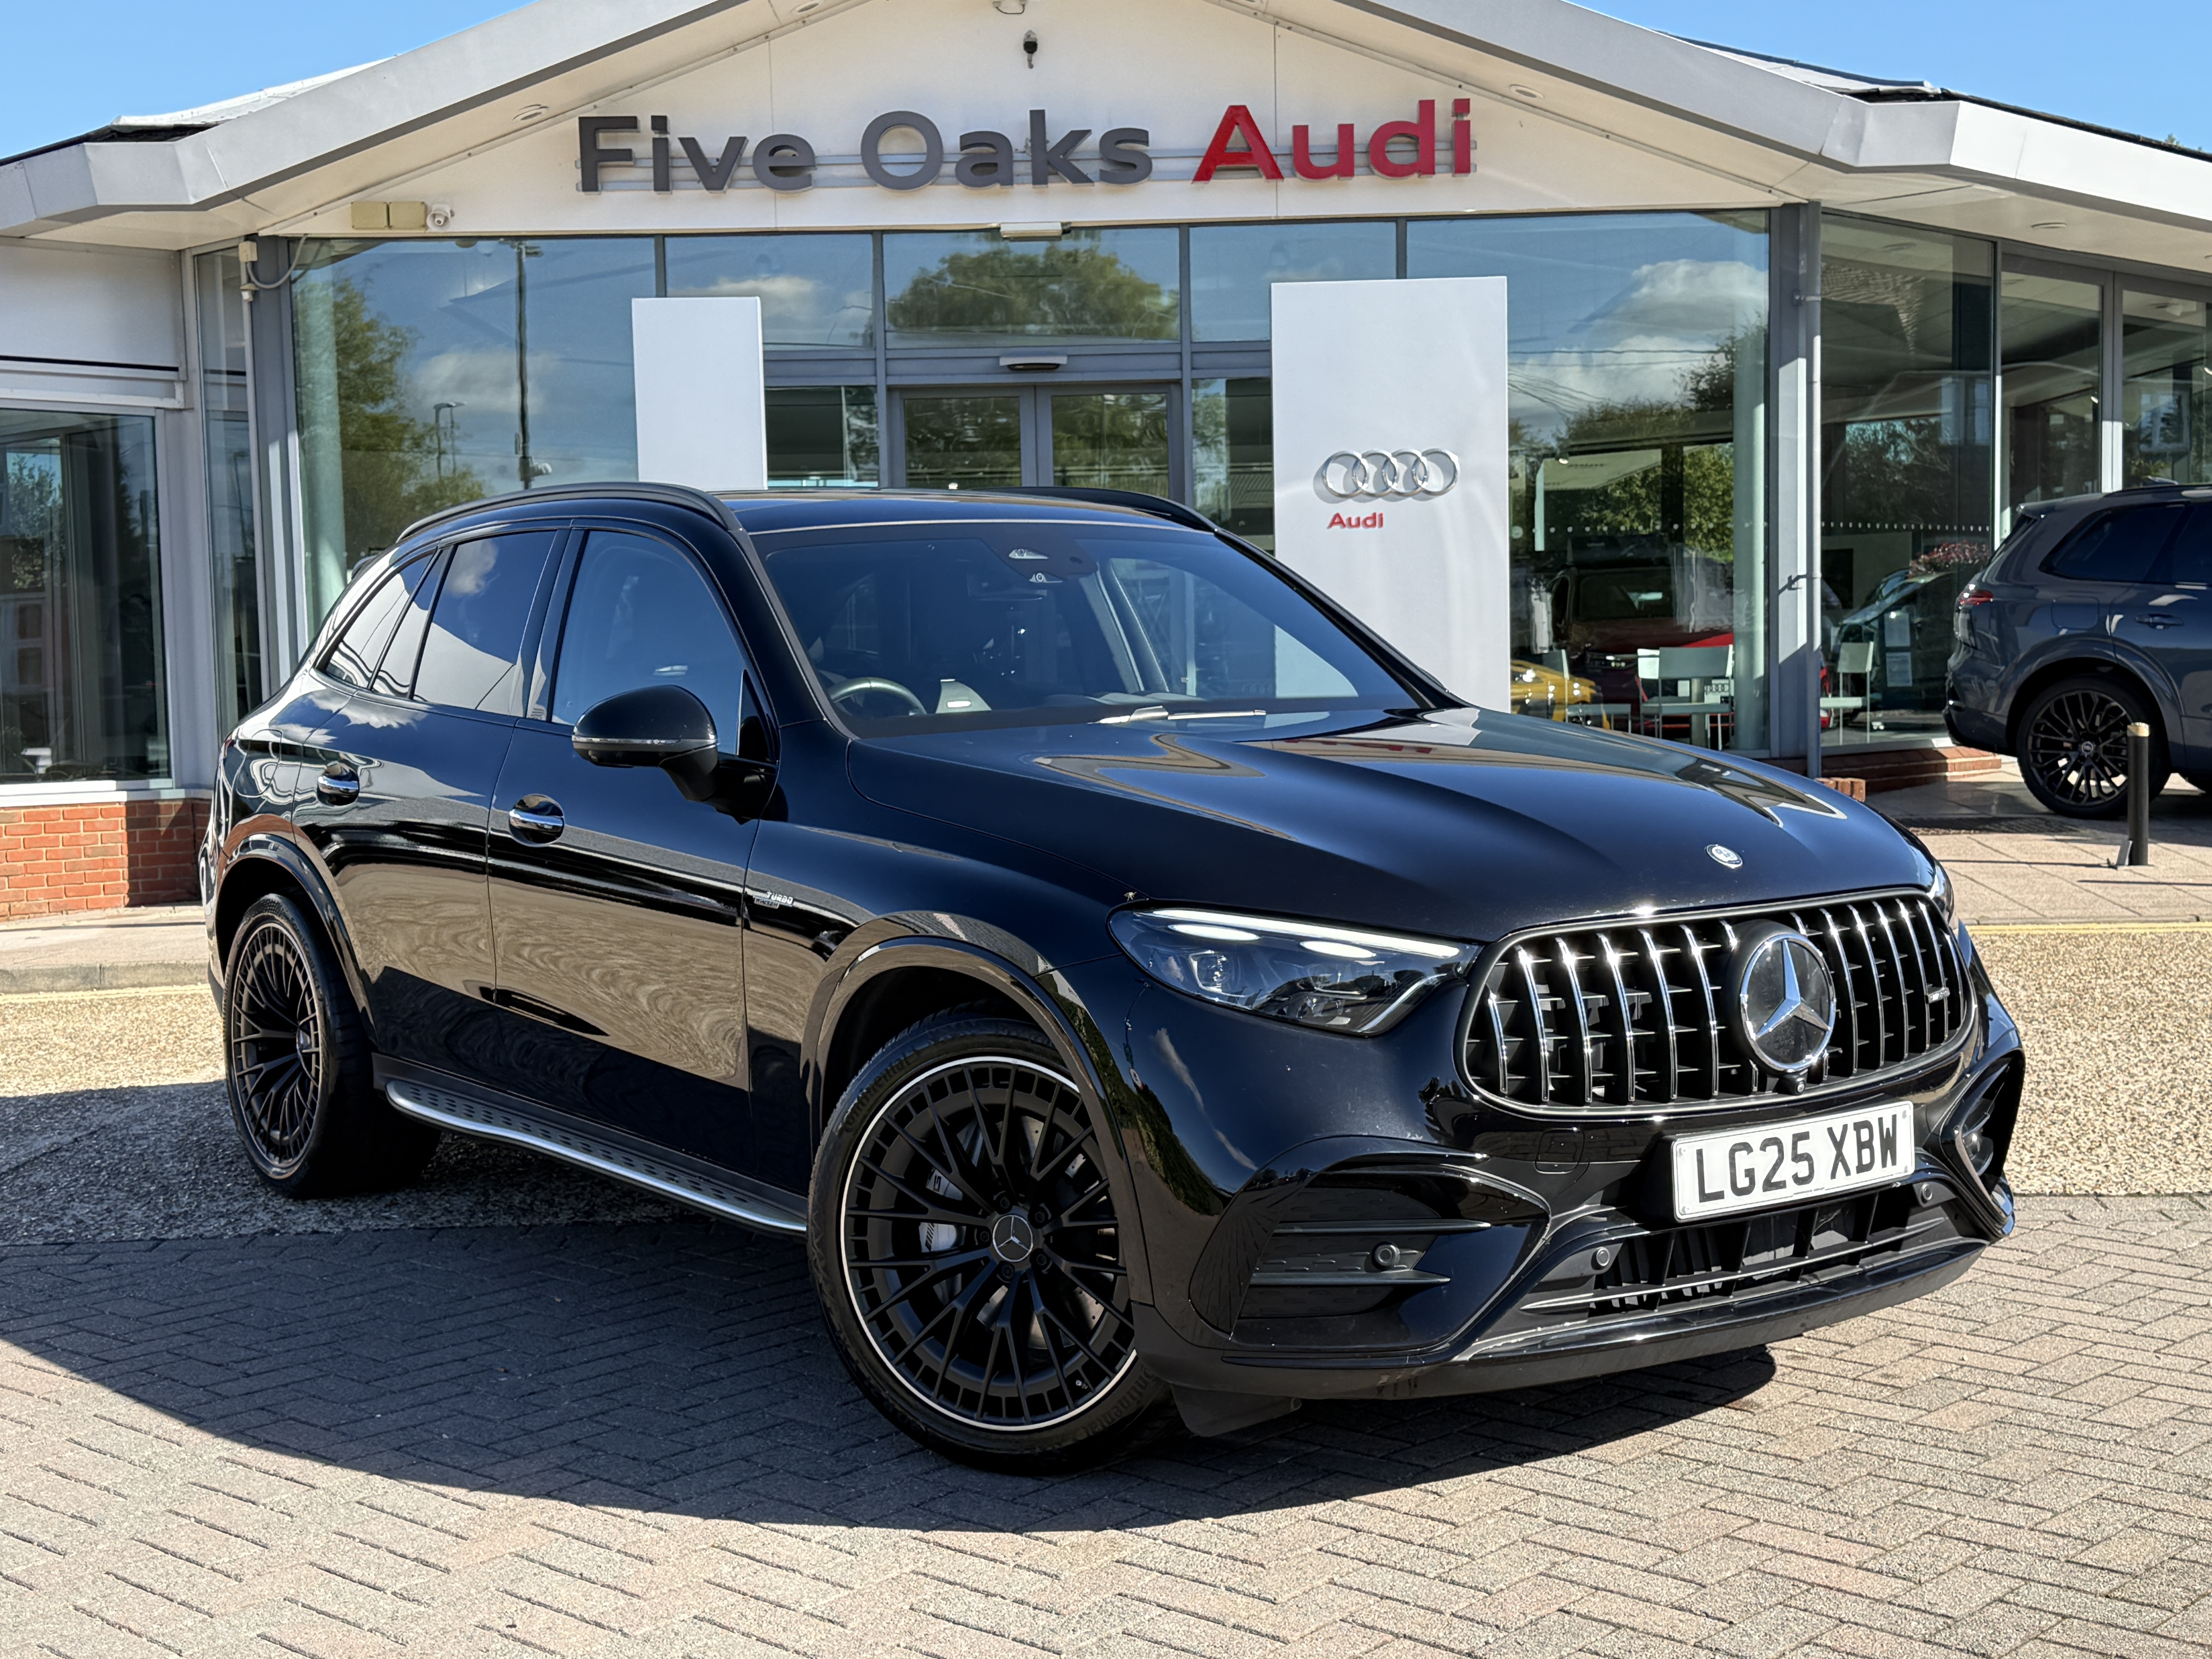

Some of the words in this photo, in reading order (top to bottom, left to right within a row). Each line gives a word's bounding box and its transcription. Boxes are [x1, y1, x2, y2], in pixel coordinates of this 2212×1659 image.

[578, 115, 816, 194] Five
[860, 109, 1152, 191] Oaks
[1191, 98, 1471, 184] Audi
[1327, 512, 1384, 529] Audi
[1696, 1131, 1815, 1203] LG25
[1827, 1114, 1897, 1180] XBW
